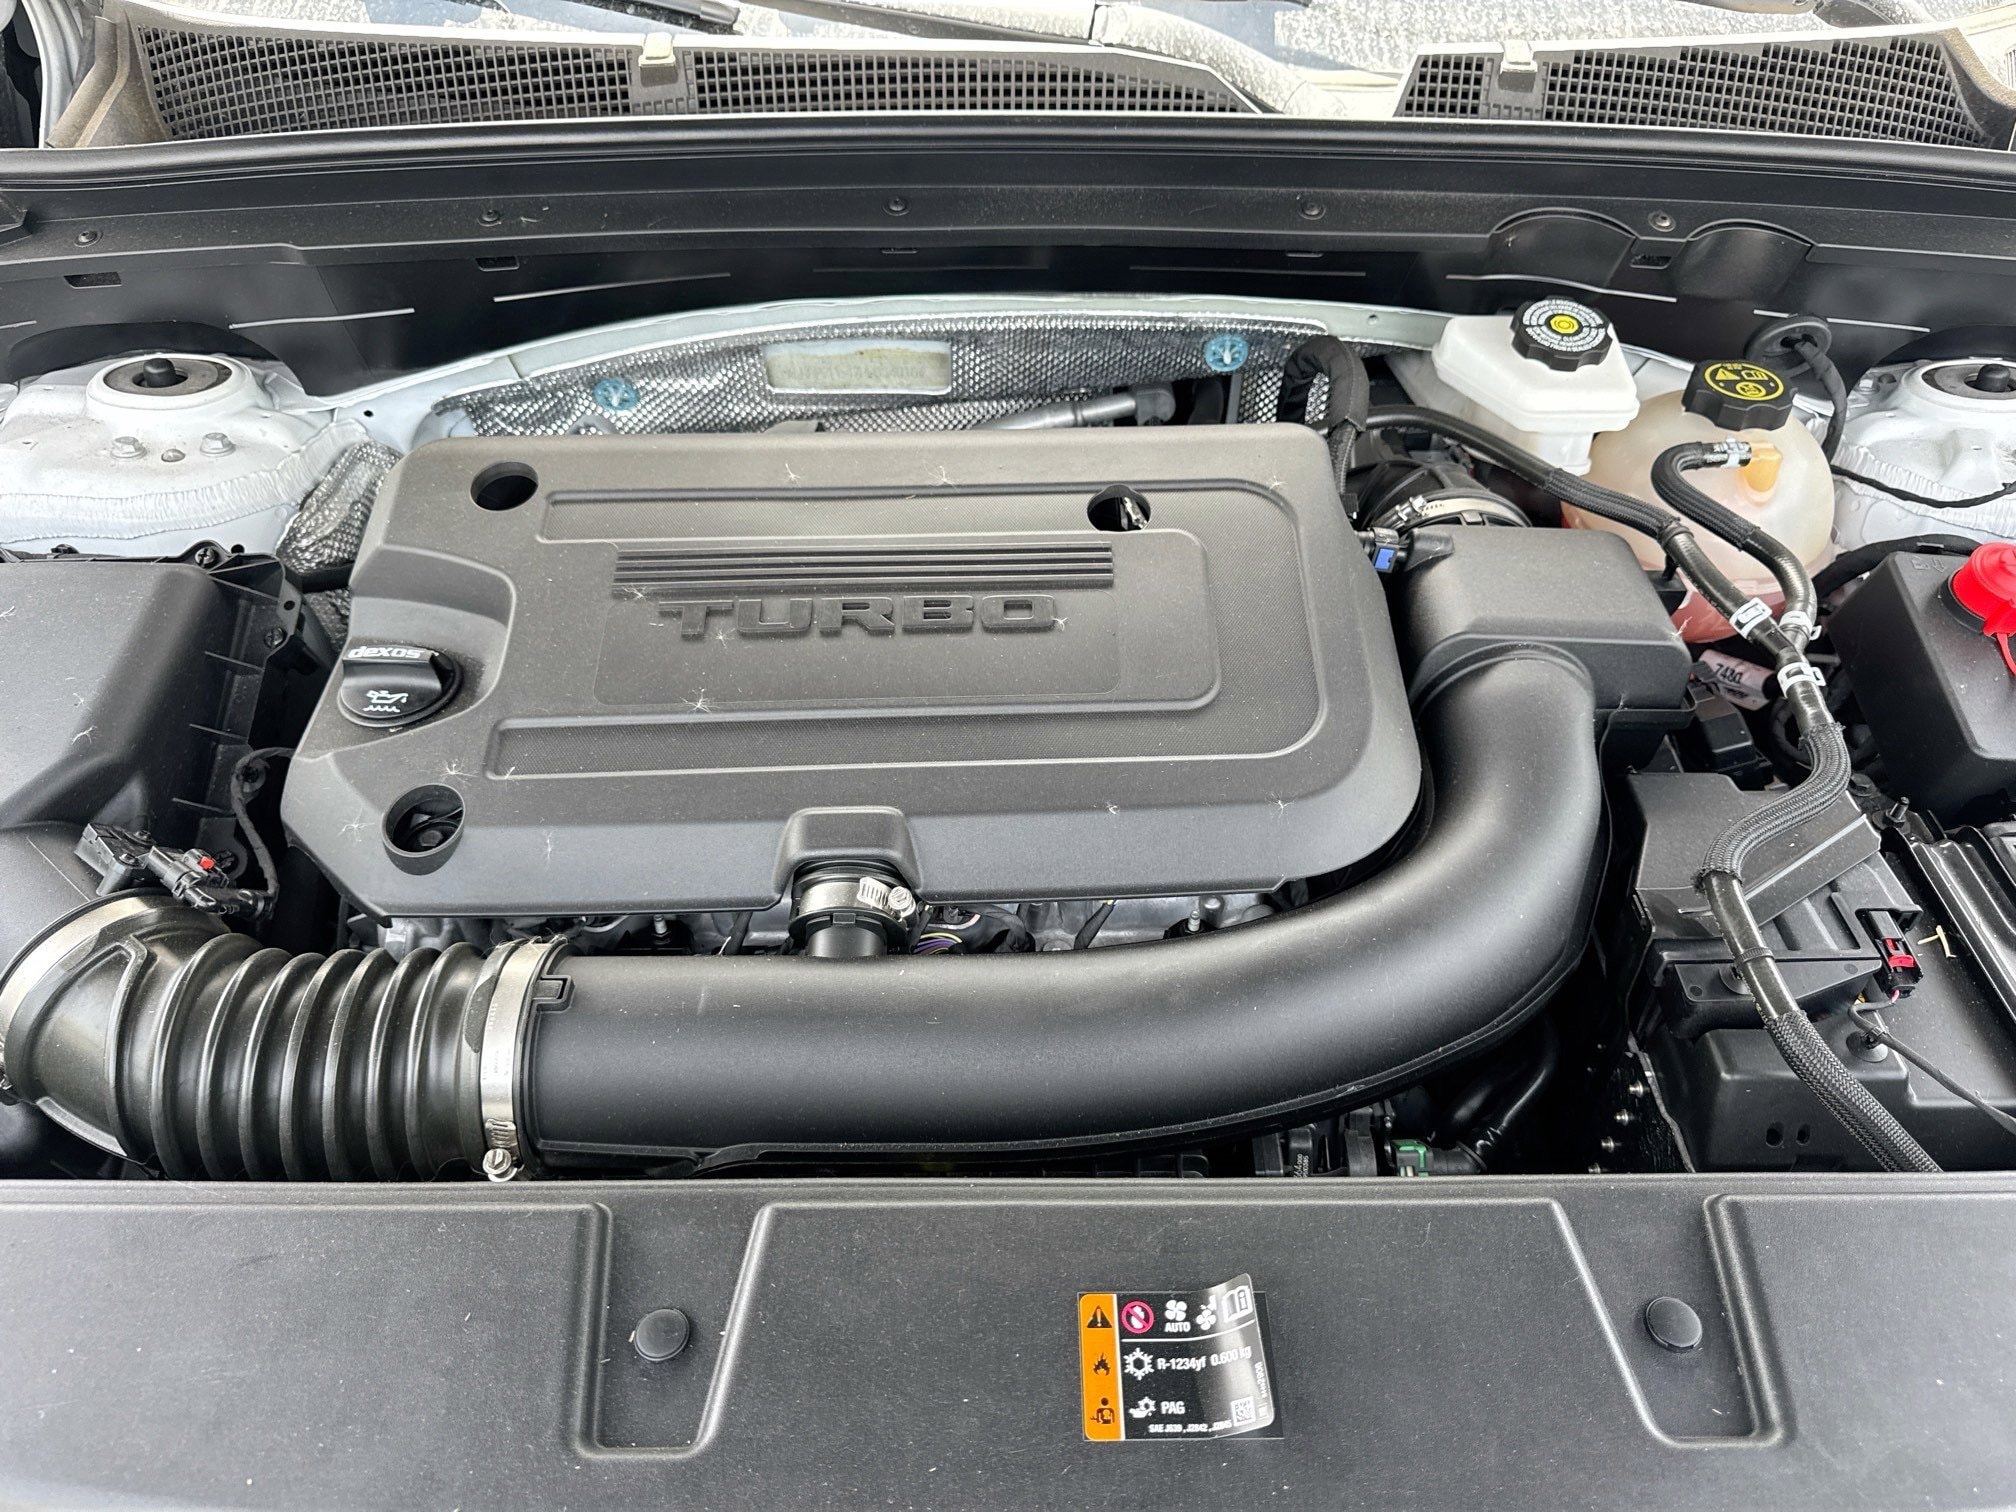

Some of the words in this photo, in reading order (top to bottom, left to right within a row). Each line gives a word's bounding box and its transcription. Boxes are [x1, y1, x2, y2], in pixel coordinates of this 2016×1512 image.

[657, 594, 1057, 641] TURBO
[347, 645, 425, 659] dexos
[1164, 1321, 1191, 1333] AUTO
[1157, 1356, 1207, 1371] R-1234yf
[1210, 1349, 1239, 1366] 0.600
[1239, 1346, 1252, 1359] kg
[1160, 1401, 1186, 1415] PAG
[1148, 1424, 1164, 1433] SAE
